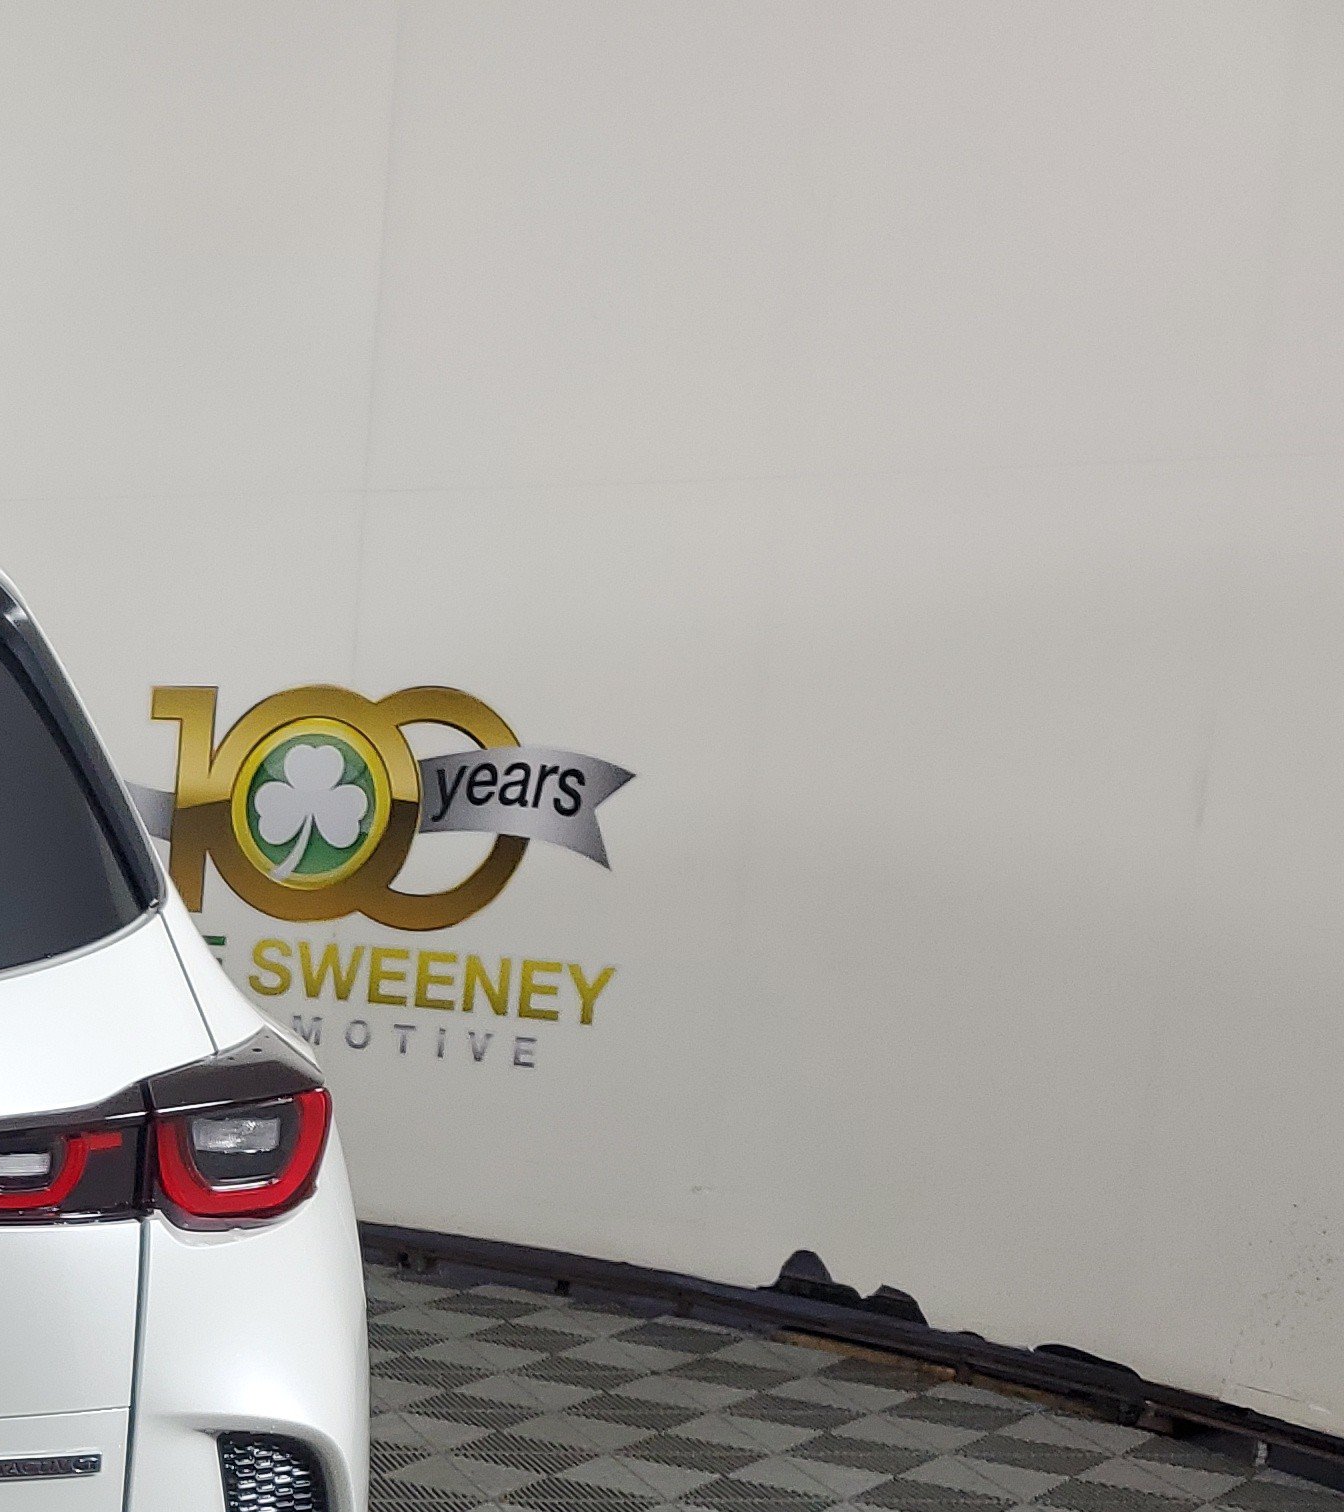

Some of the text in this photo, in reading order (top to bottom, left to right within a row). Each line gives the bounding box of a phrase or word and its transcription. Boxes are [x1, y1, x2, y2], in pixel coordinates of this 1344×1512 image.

[431, 760, 586, 823] years
[248, 937, 616, 1026] SWEENEY
[291, 1014, 538, 1069] MOTIVE
